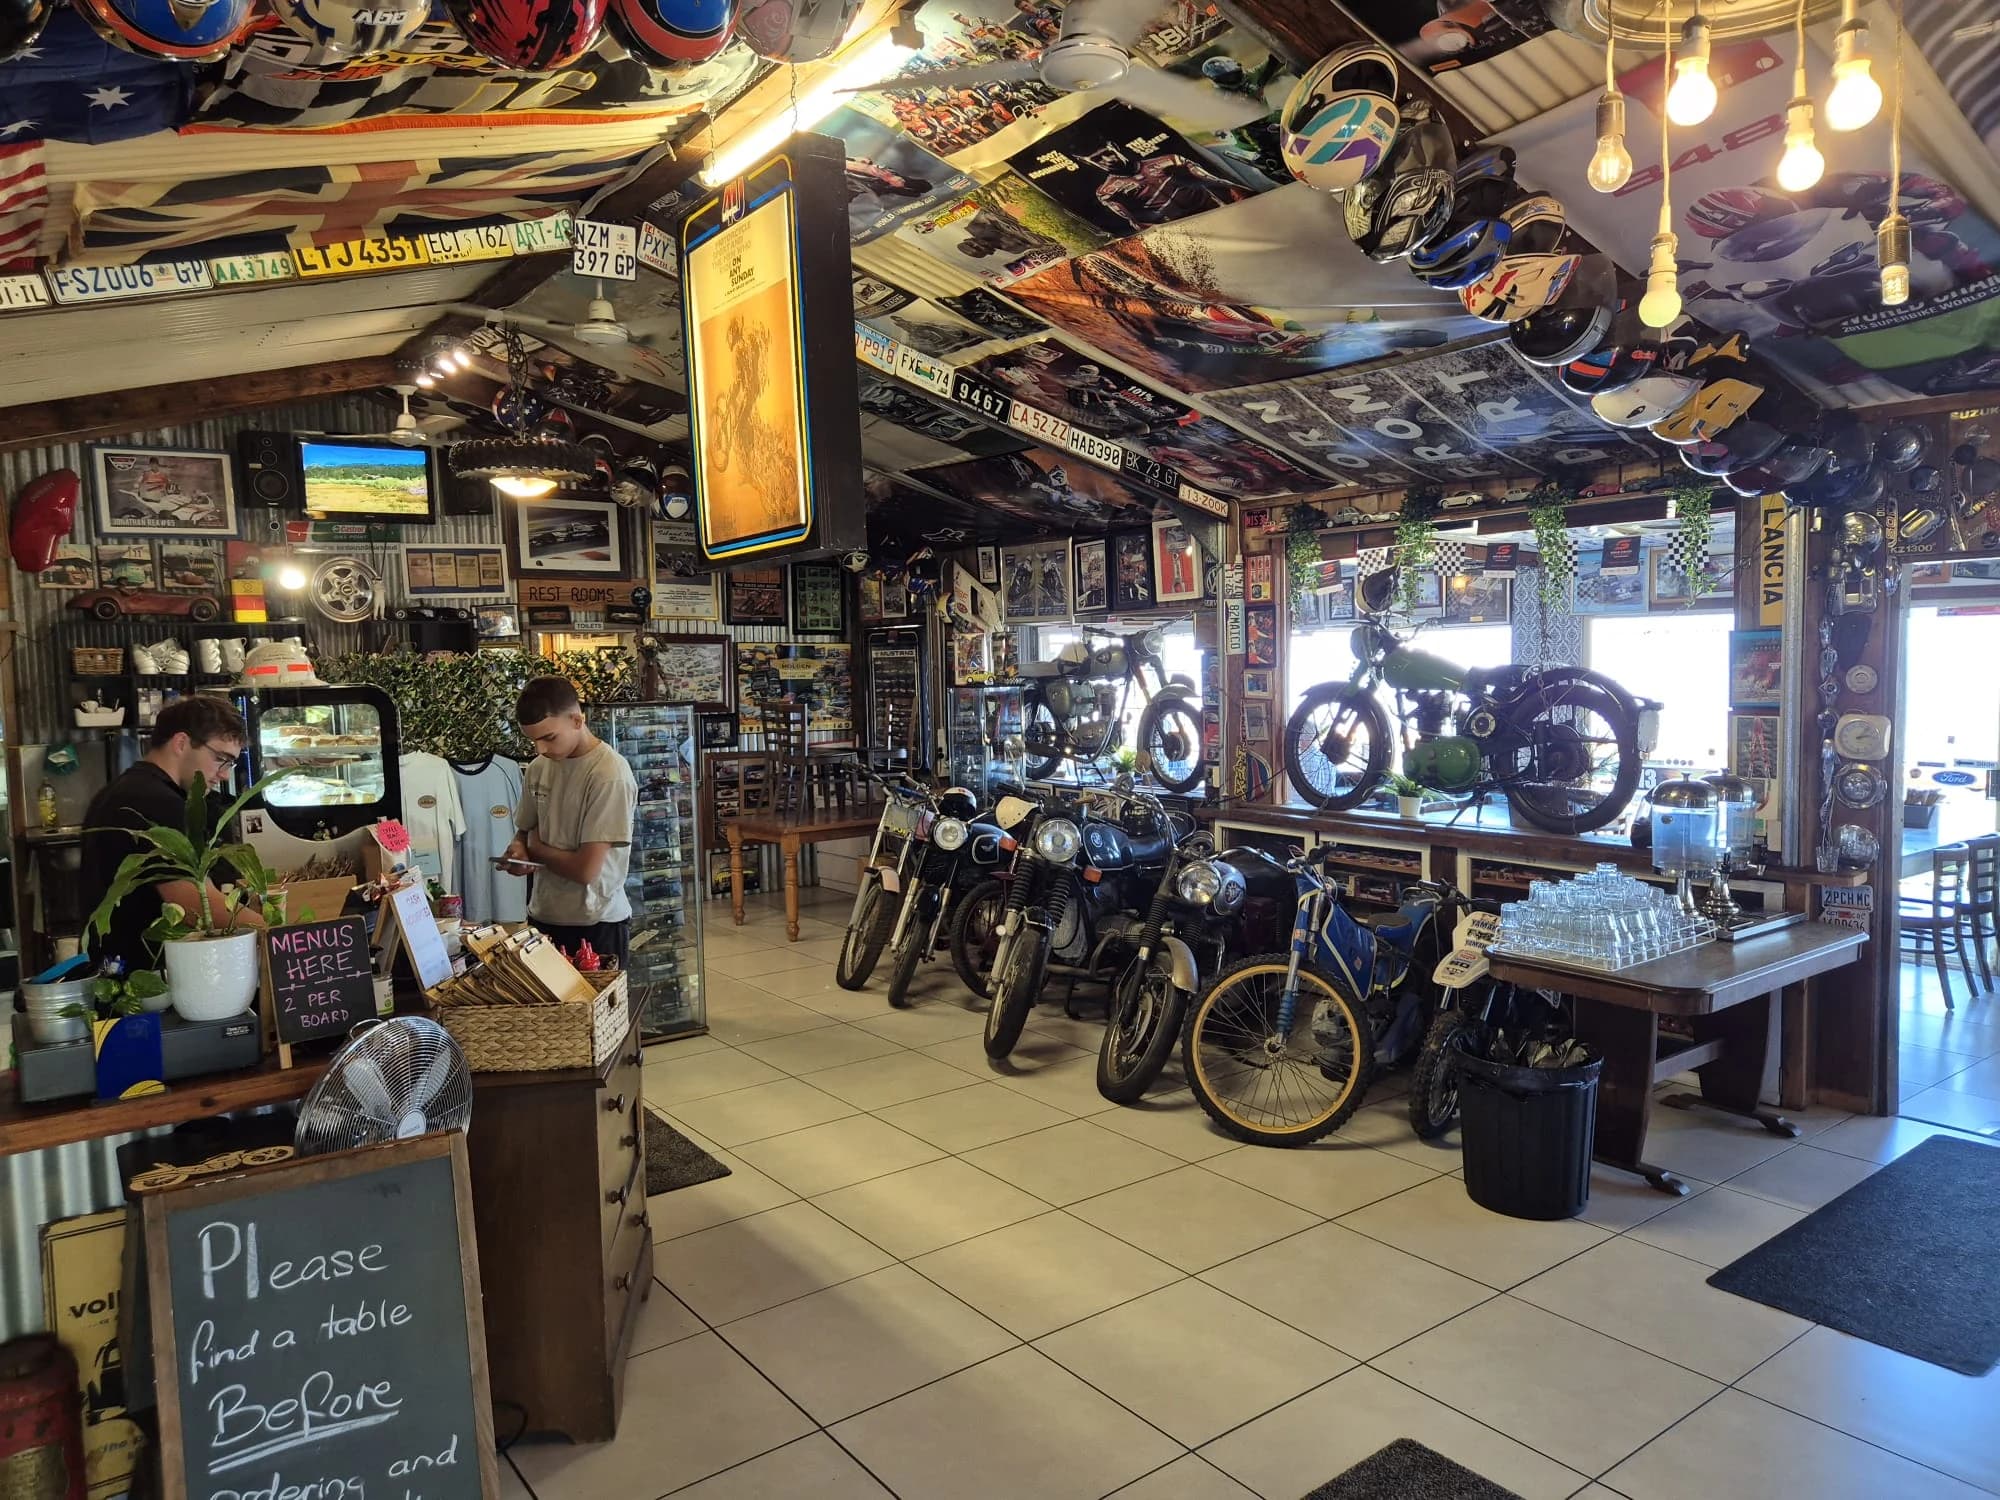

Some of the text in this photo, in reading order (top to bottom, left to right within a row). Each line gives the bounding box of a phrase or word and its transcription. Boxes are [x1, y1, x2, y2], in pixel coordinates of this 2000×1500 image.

[475, 226, 507, 250] 162
[575, 223, 609, 248] NZM
[174, 259, 203, 285] GP
[575, 250, 635, 276] 397 GP
[729, 264, 742, 278] ANY
[732, 255, 742, 267] ON
[731, 267, 755, 287] SUNDAY
[1870, 306, 1938, 330] SUPERBIKE
[1939, 291, 1987, 310] WORLD
[958, 383, 1004, 416] 9467
[1127, 385, 1155, 402] 101%
[1071, 431, 1120, 465] HAB390
[1126, 450, 1140, 470] BK
[1147, 459, 1161, 480] 73
[1165, 468, 1178, 487] GT
[1763, 508, 1785, 606] LANCIA
[528, 585, 615, 603] REST ROOMS
[1939, 772, 1968, 784] Ford
[271, 924, 353, 955] MENUS
[286, 950, 353, 980] HERE
[284, 989, 342, 1013] 2 PER
[300, 1009, 349, 1028] BOARD
[198, 1221, 391, 1300] Please
[191, 1300, 413, 1384] find a table
[209, 1370, 404, 1448] Before
[388, 1433, 458, 1477] and
